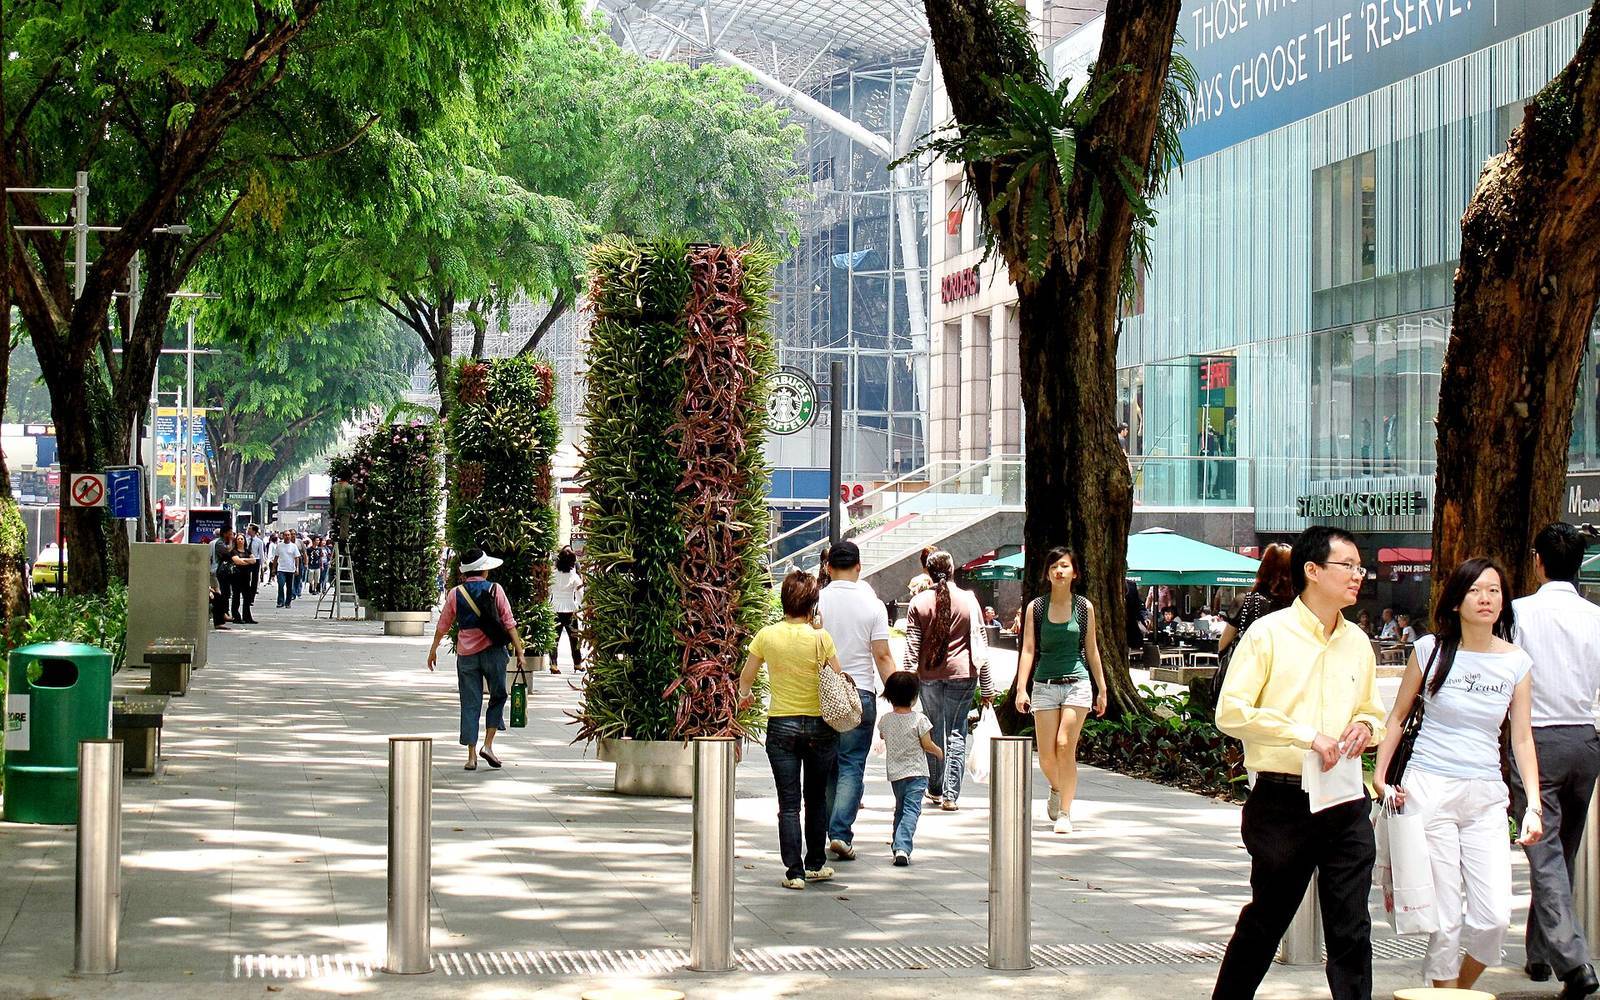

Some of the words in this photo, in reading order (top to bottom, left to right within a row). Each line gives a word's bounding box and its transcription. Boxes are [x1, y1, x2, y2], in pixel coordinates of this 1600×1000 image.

[1192, 0, 1248, 50] THOSE
[1229, 33, 1308, 109] CHOOSE
[1314, 12, 1352, 73] THE
[941, 267, 978, 304] BORDERS
[766, 375, 812, 402] RBUCKS
[1296, 492, 1364, 517] STARBUCKS
[1366, 491, 1416, 516] COFFEE
